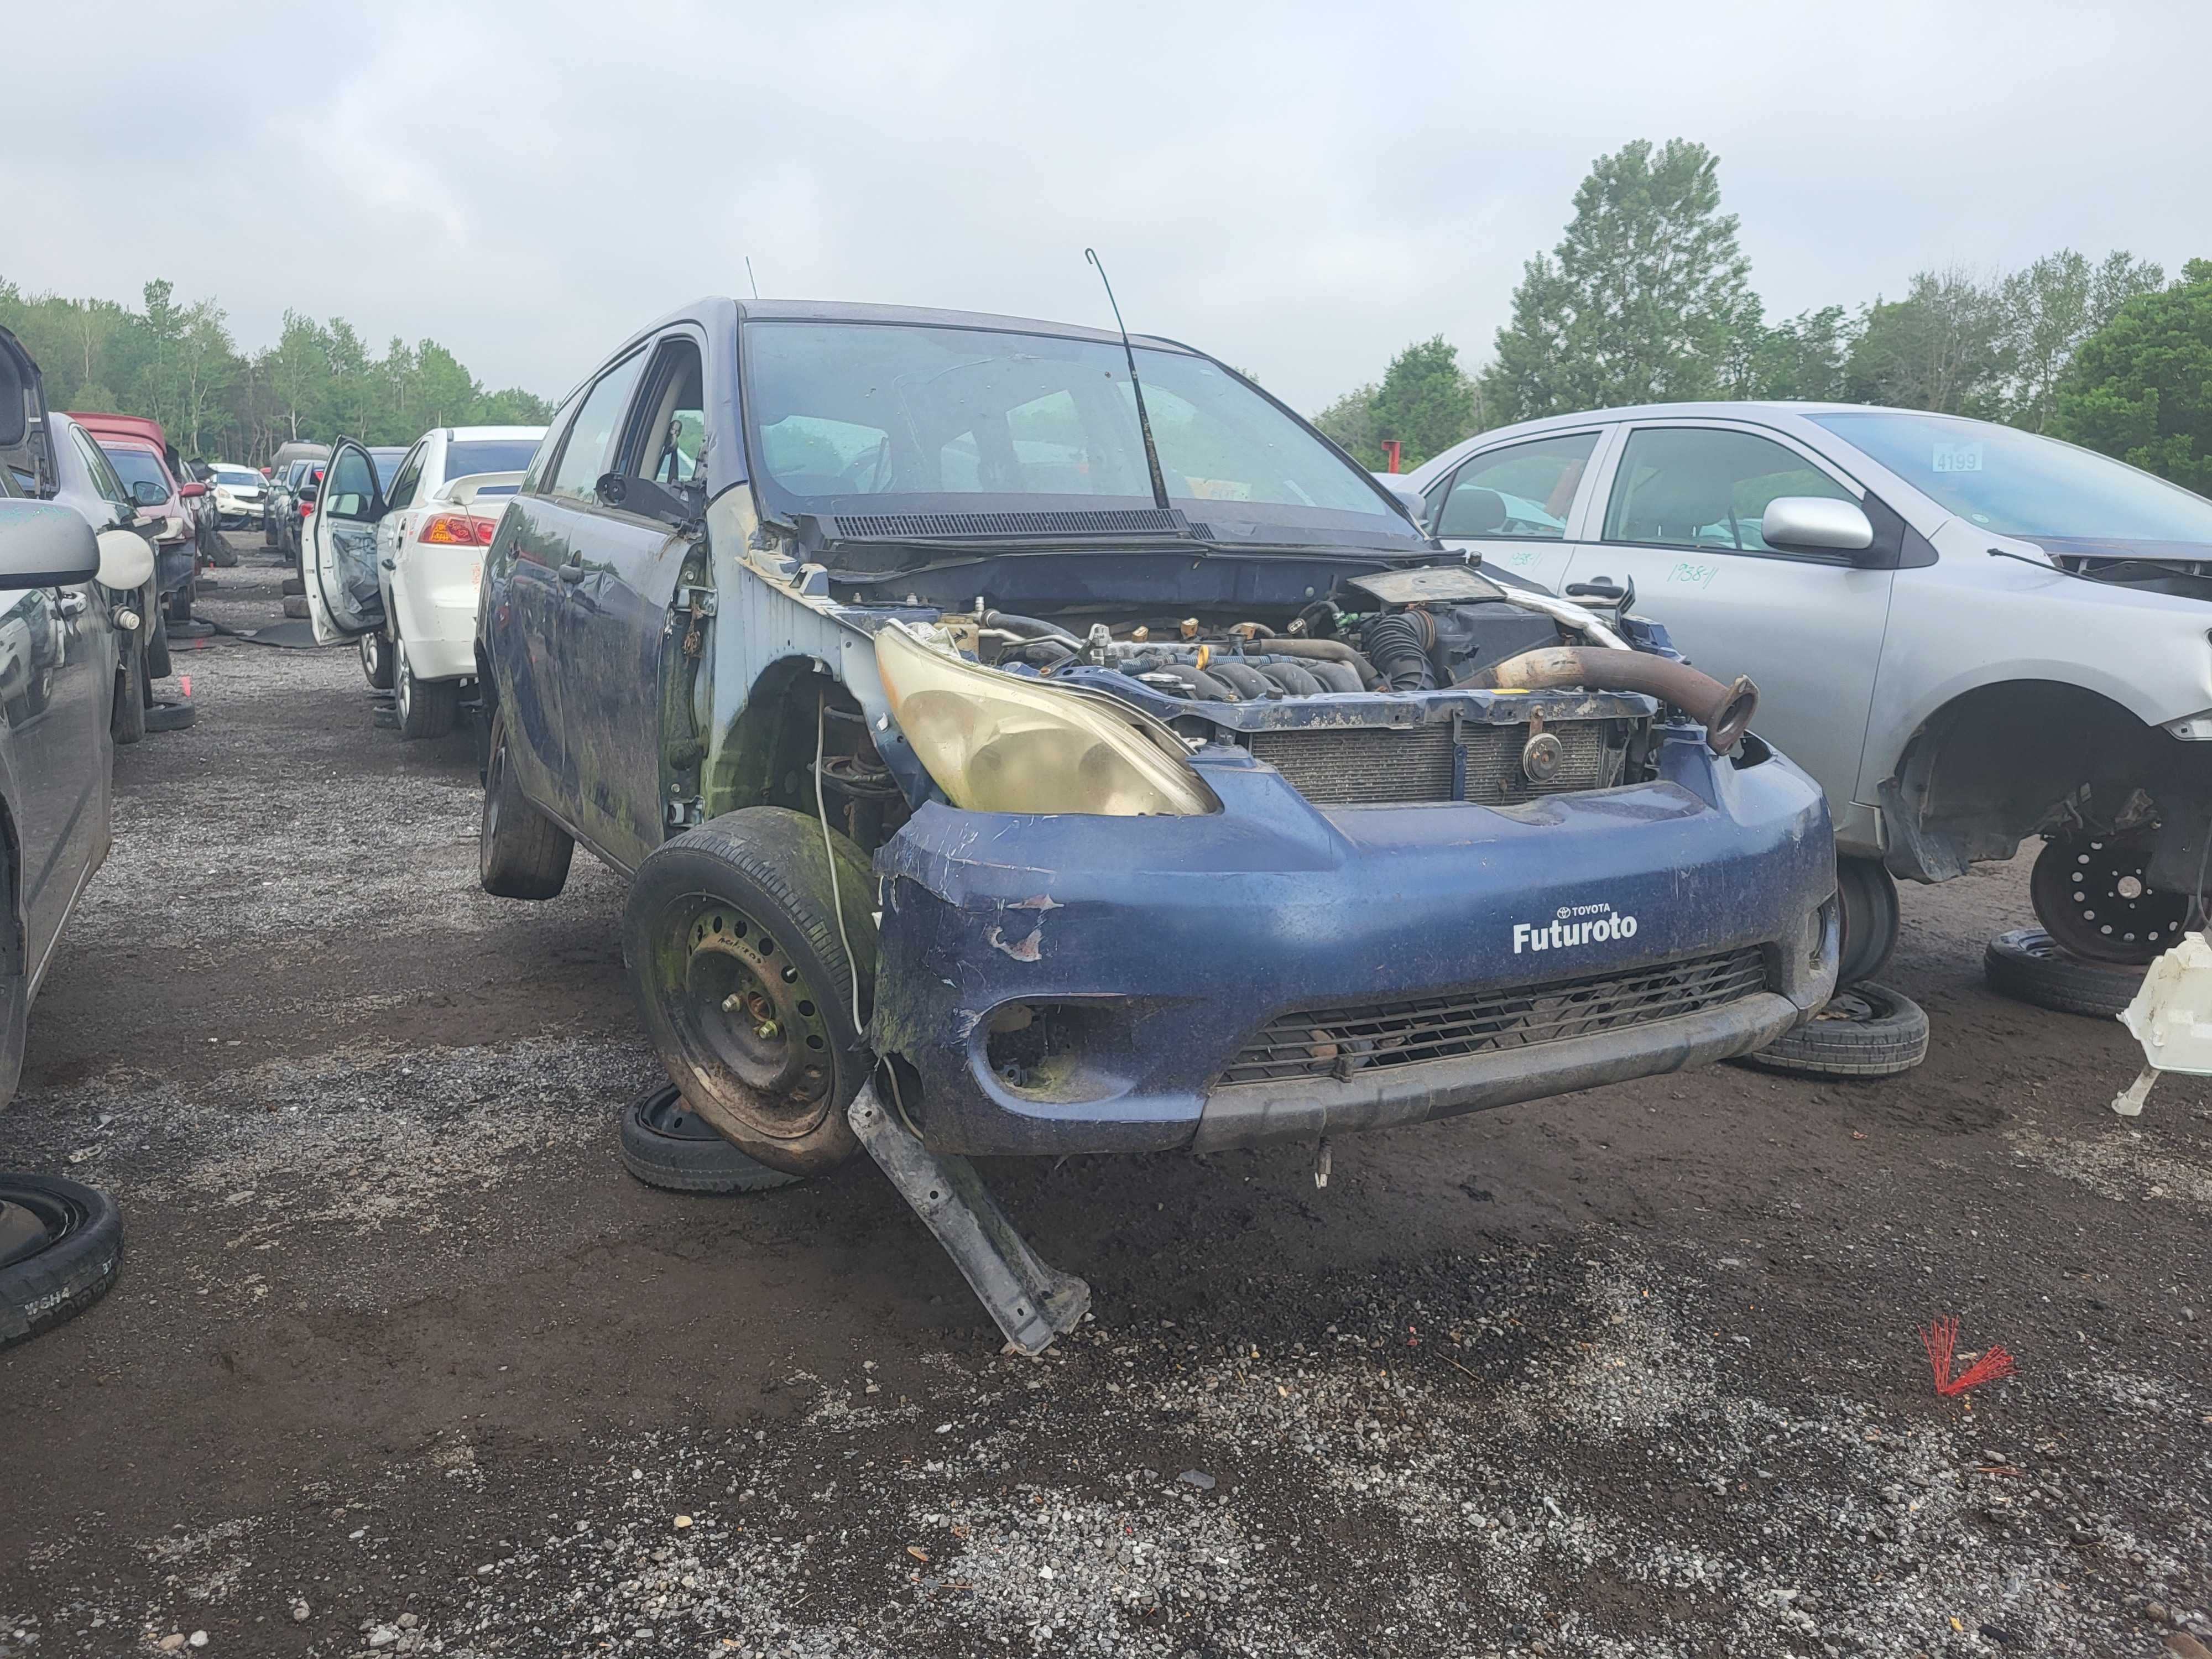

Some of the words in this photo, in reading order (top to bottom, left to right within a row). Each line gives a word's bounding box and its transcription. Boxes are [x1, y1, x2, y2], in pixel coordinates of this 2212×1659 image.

[1937, 453, 1977, 470] 4199
[1572, 902, 1610, 916] TOYOTA
[1513, 911, 1637, 954] Futuroto
